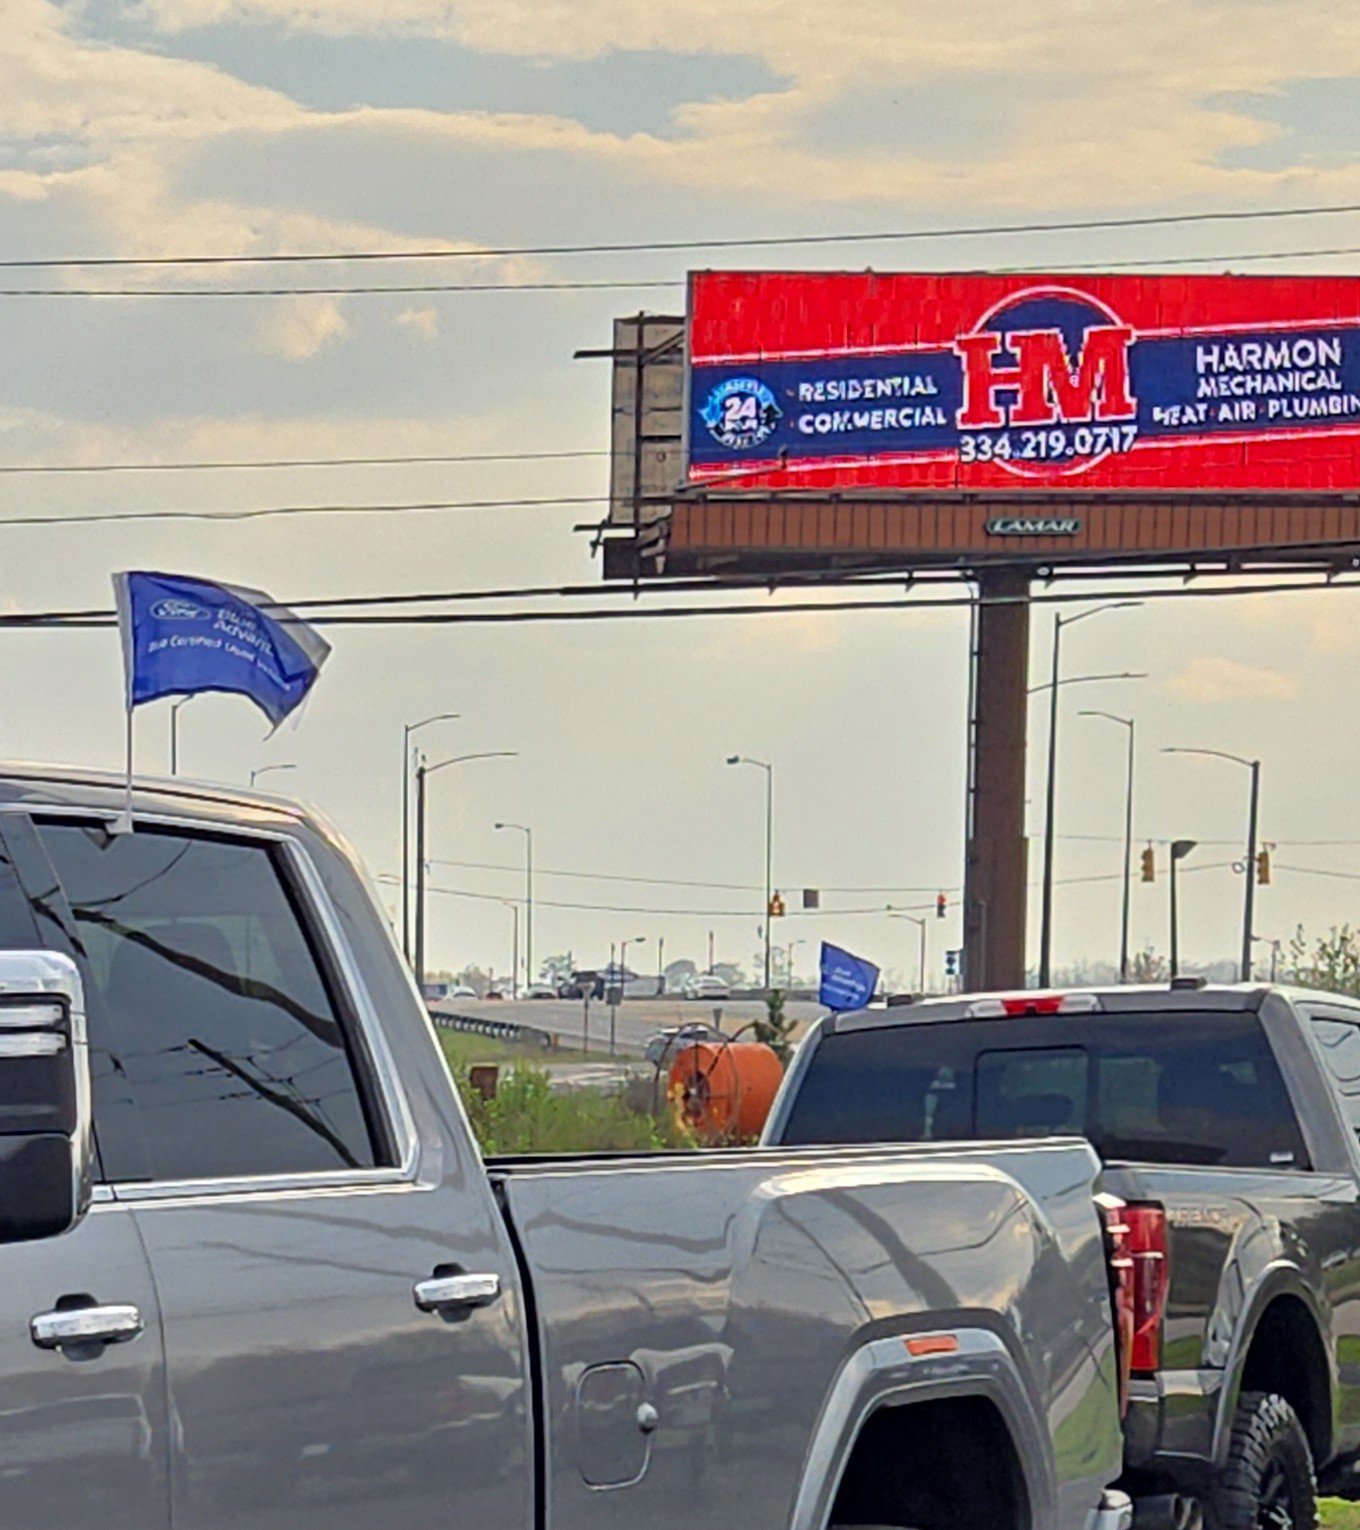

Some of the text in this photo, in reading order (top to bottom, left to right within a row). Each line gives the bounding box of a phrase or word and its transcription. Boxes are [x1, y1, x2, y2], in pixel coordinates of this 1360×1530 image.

[1196, 337, 1342, 374] HARMON
[798, 376, 938, 402] RESIDENTIAL
[953, 325, 1137, 430] HM
[1196, 369, 1342, 399] MECHANICAL
[798, 407, 948, 434] COMMERCIAL
[1218, 400, 1256, 423] AIR
[960, 425, 1138, 462] 334.219.0717
